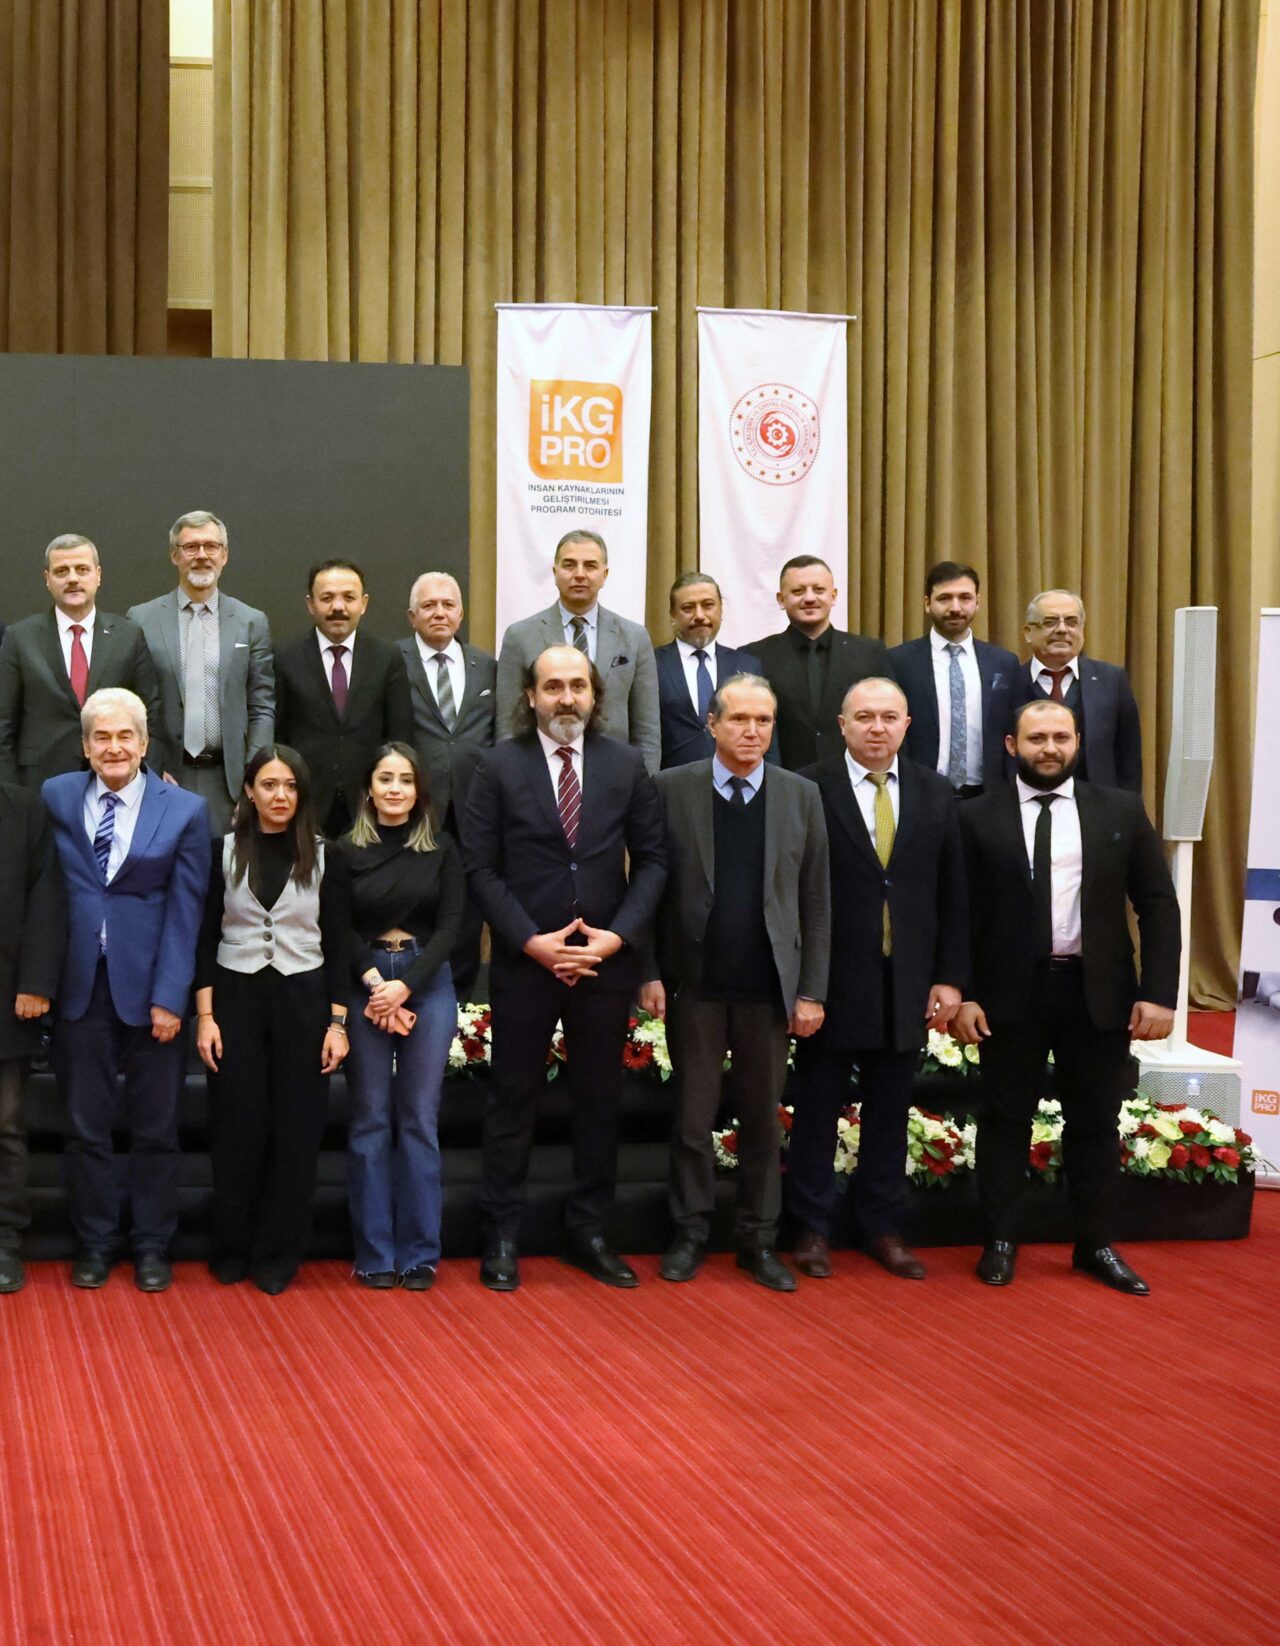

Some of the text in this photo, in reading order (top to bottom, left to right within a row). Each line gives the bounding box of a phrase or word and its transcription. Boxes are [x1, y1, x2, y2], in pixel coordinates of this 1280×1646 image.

[540, 435, 612, 469] PRO
[528, 483, 625, 495] İNSAN KAYNAKLARININ
[531, 505, 576, 514] PROGRAM
[1254, 1102, 1277, 1112] PRO
